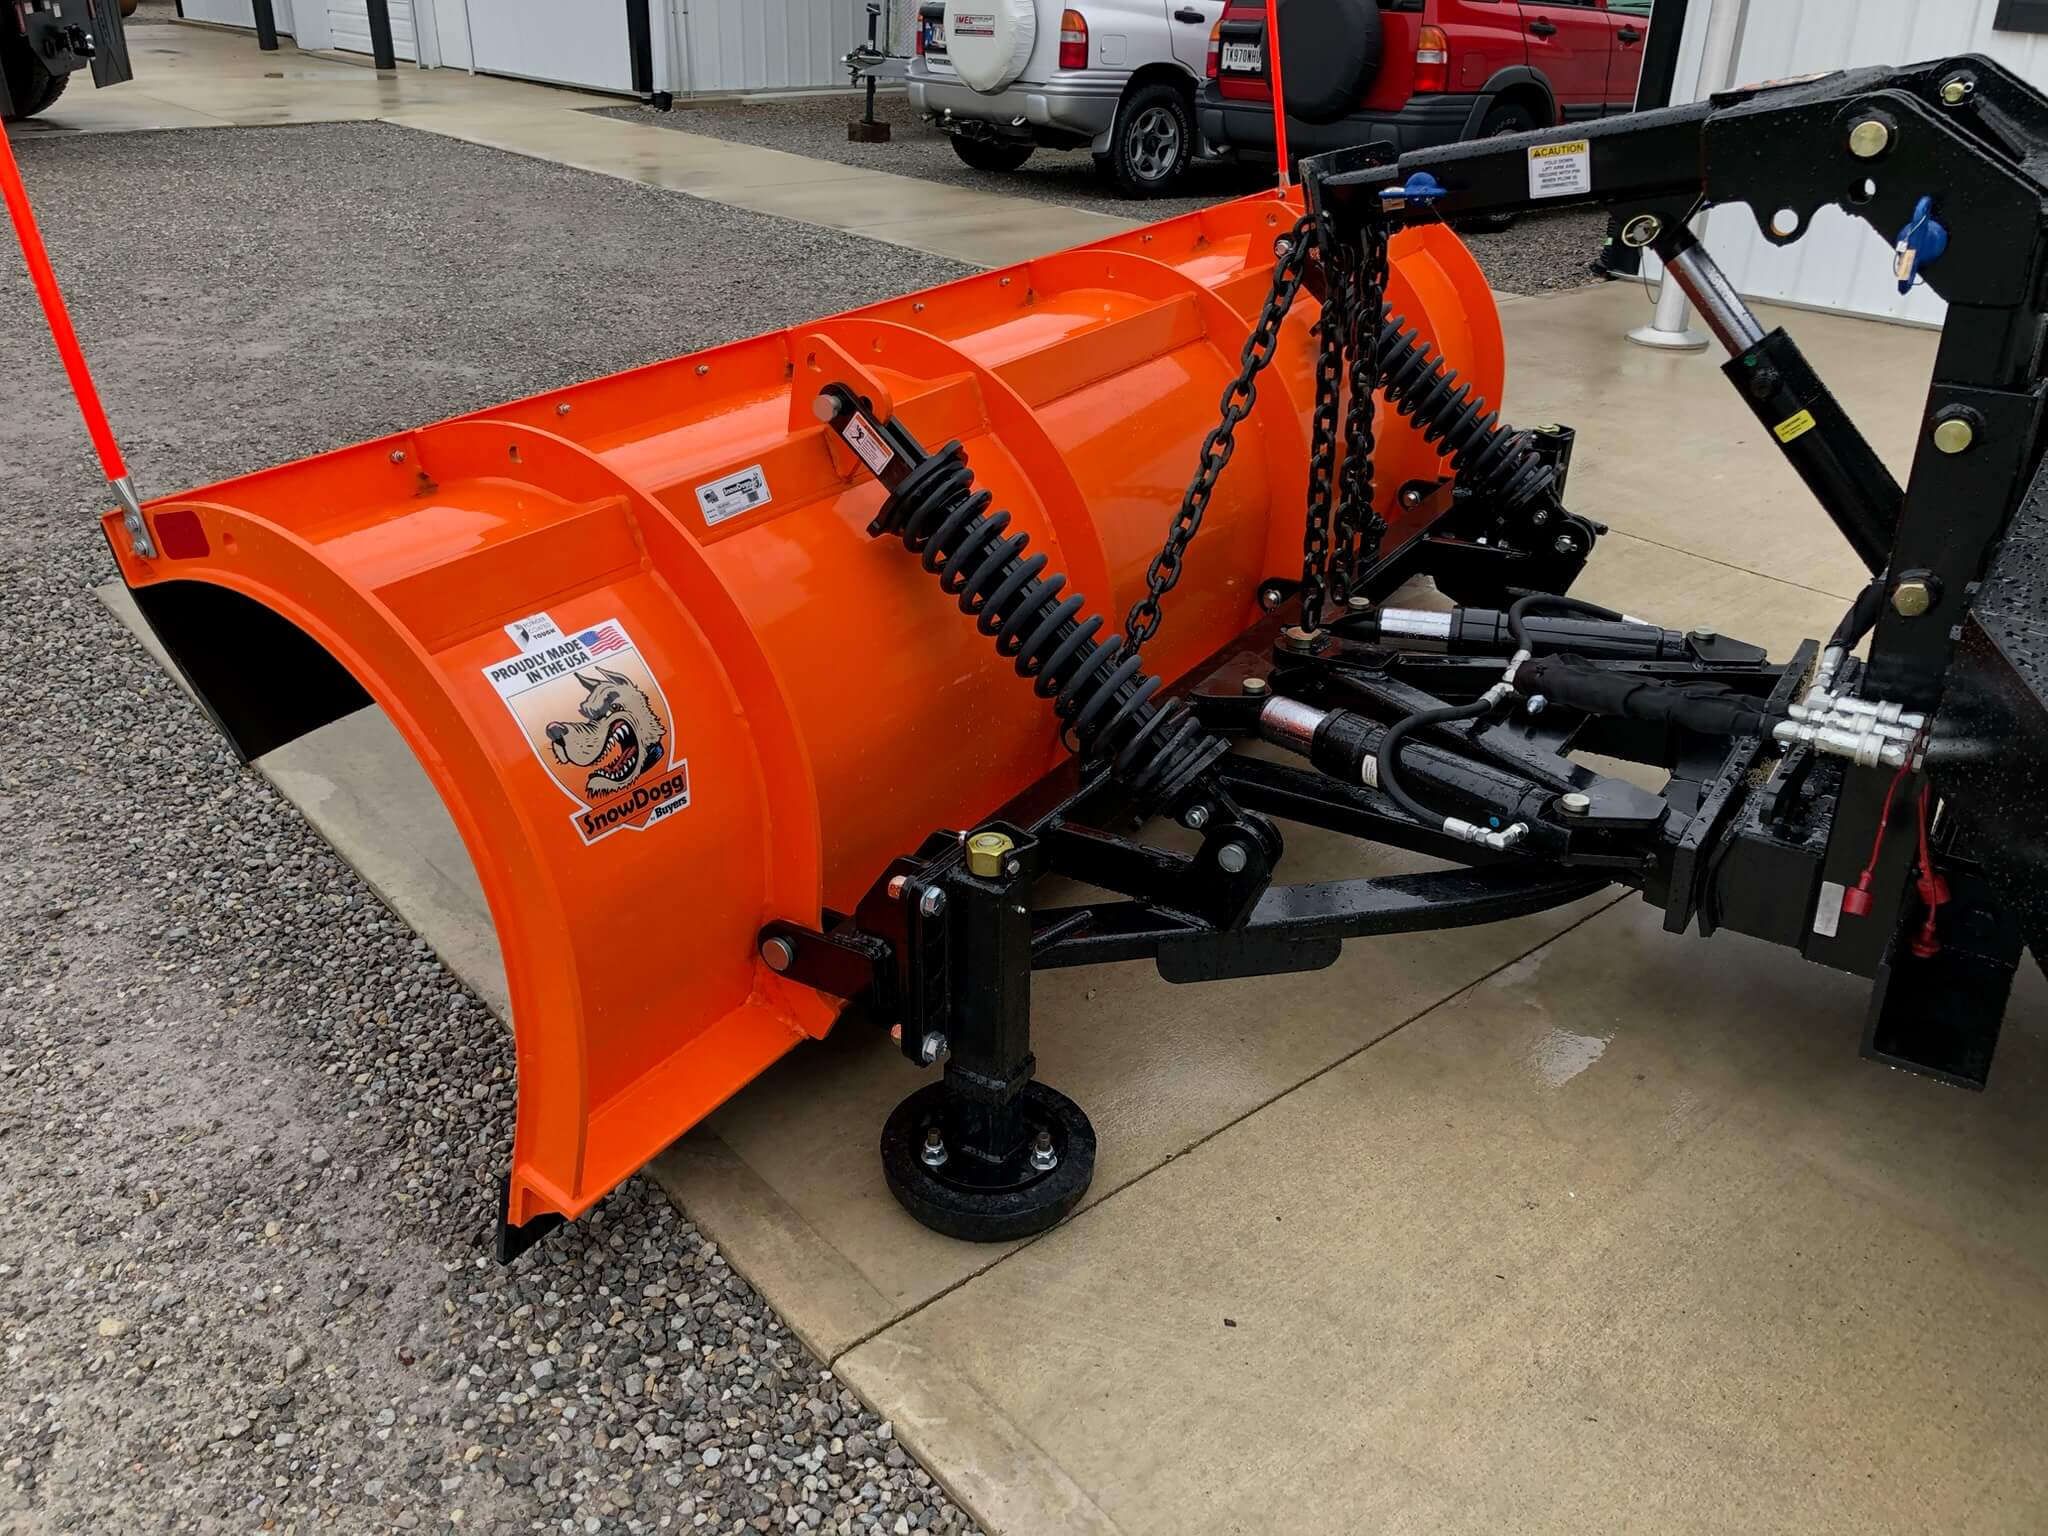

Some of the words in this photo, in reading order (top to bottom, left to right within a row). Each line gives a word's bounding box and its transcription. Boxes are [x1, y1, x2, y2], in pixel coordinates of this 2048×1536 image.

[1541, 143, 1584, 156] CAUTION
[533, 628, 556, 639] TOUGH
[490, 653, 546, 682] PROUDLY
[545, 639, 583, 660] MADE
[526, 669, 543, 684] IN
[540, 660, 566, 678] THE
[567, 651, 591, 668] USA
[583, 774, 685, 835] SnowDogg
[655, 796, 688, 819] Buyers
